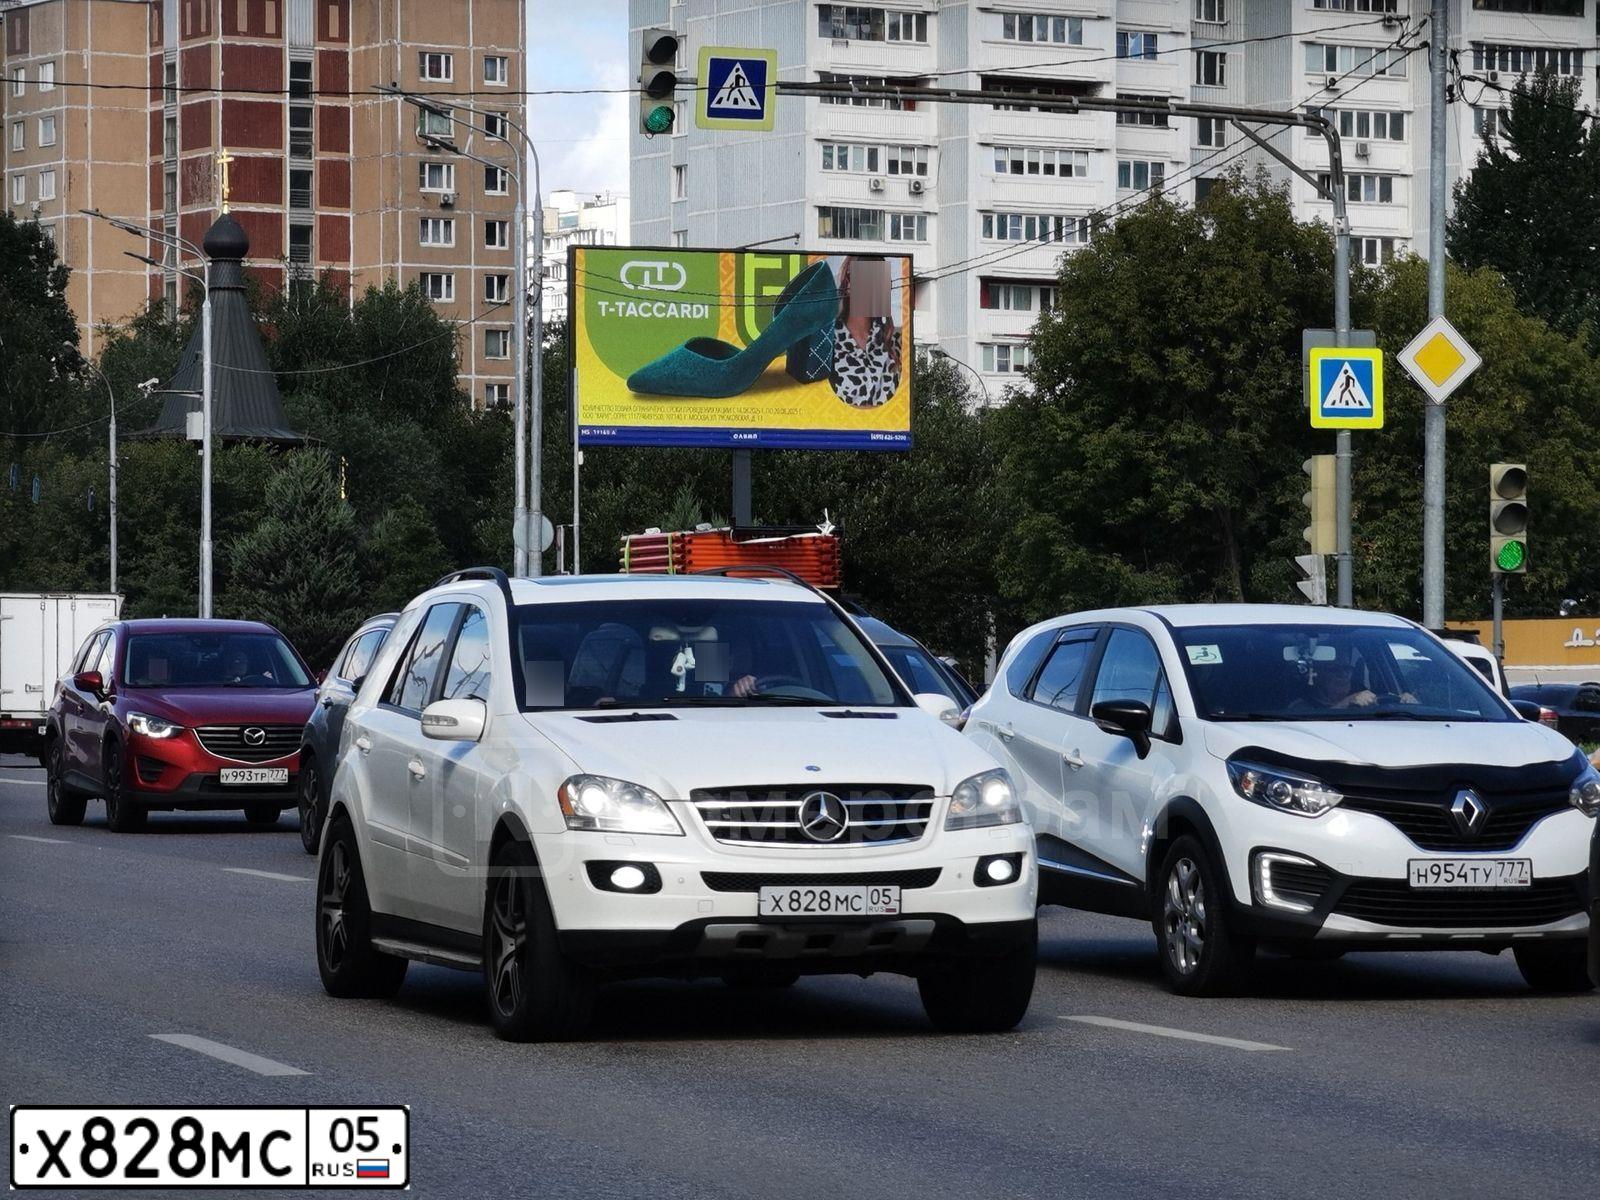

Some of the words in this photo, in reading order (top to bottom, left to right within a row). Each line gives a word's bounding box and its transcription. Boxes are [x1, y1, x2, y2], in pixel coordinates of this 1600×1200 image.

[598, 300, 709, 319] T-TACCARDI
[224, 770, 267, 782] У993ТР
[269, 769, 285, 778] 777
[1417, 863, 1493, 884] Н954ТУ
[1497, 861, 1525, 878] 777
[770, 889, 862, 913] Х828МС
[870, 888, 892, 906] 05
